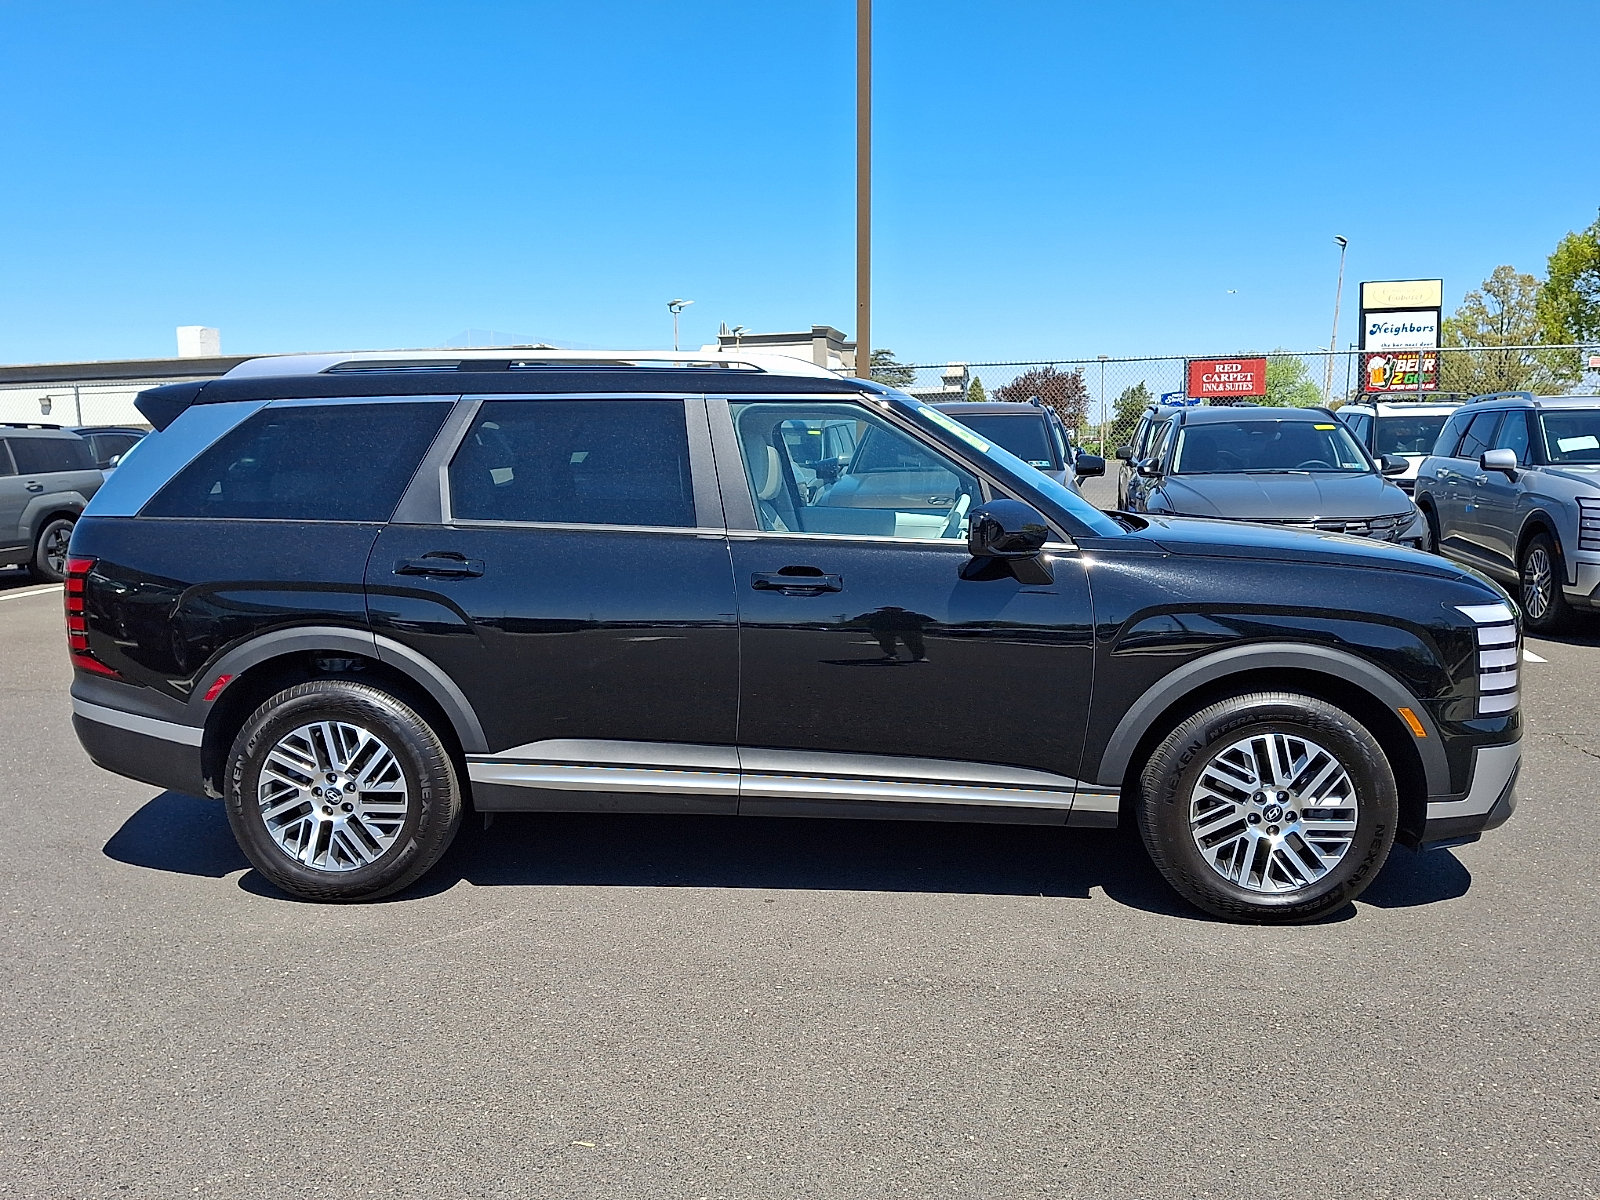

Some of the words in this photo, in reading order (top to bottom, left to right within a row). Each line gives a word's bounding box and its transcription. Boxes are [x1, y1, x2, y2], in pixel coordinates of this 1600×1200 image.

[1369, 322, 1435, 336] Neighbors
[1215, 363, 1242, 373] RED
[1202, 372, 1254, 383] CARPET
[1224, 381, 1253, 391] SUITES
[1164, 740, 1204, 805] NEXEN
[1346, 823, 1386, 887] NEXEN
